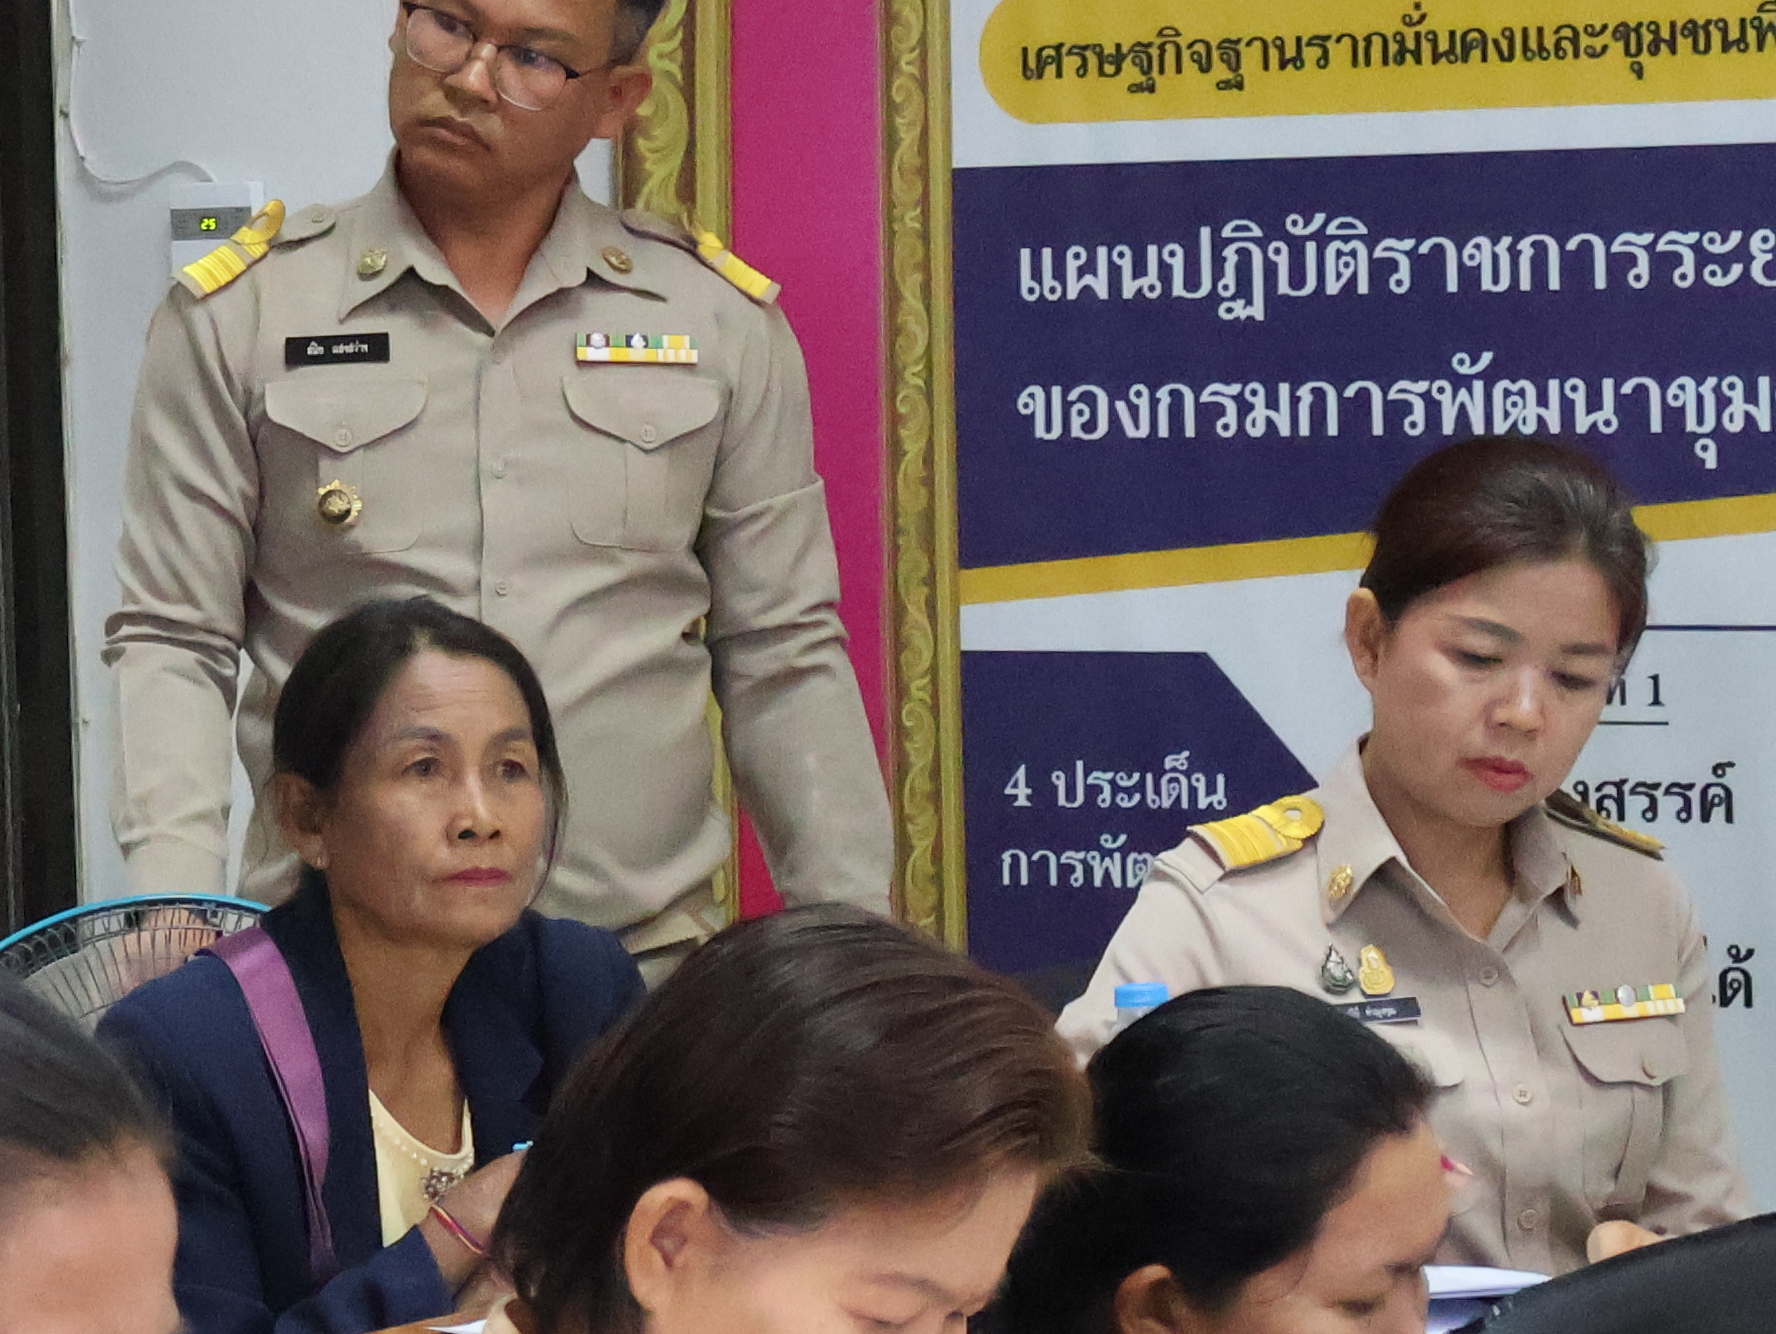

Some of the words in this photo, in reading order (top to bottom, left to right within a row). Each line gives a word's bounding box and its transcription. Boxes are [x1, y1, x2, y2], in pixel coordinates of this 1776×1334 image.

[200, 218, 216, 230] 25
[1016, 351, 1776, 470] ของกรมการพัฒนาชุม
[1647, 673, 1665, 707] 1
[1004, 764, 1032, 806] 4
[1051, 750, 1227, 810] ประเด็น
